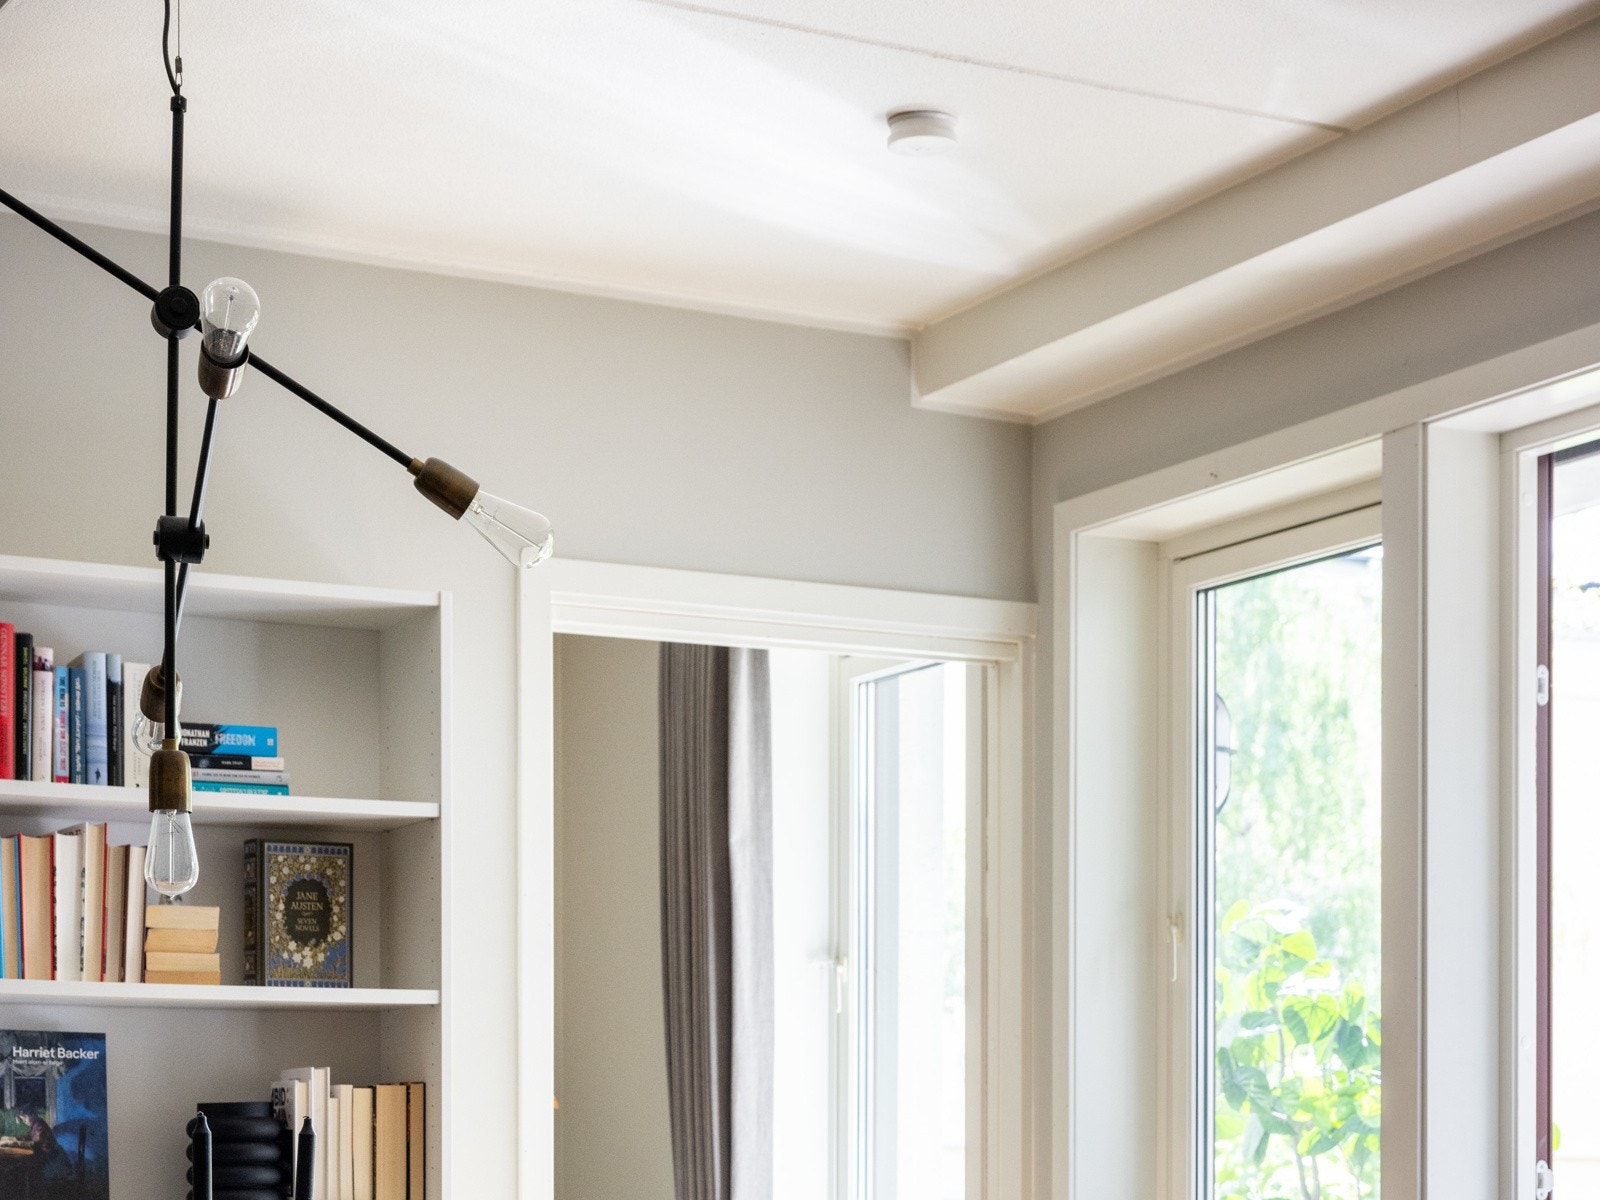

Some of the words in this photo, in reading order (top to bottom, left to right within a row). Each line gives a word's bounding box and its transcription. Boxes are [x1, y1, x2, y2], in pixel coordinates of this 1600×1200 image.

[214, 733, 256, 746] FREEDOM
[296, 892, 318, 900] JANE
[291, 902, 324, 910] AUSTEN
[12, 1046, 55, 1058] Harriet
[57, 1047, 100, 1060] Backer
